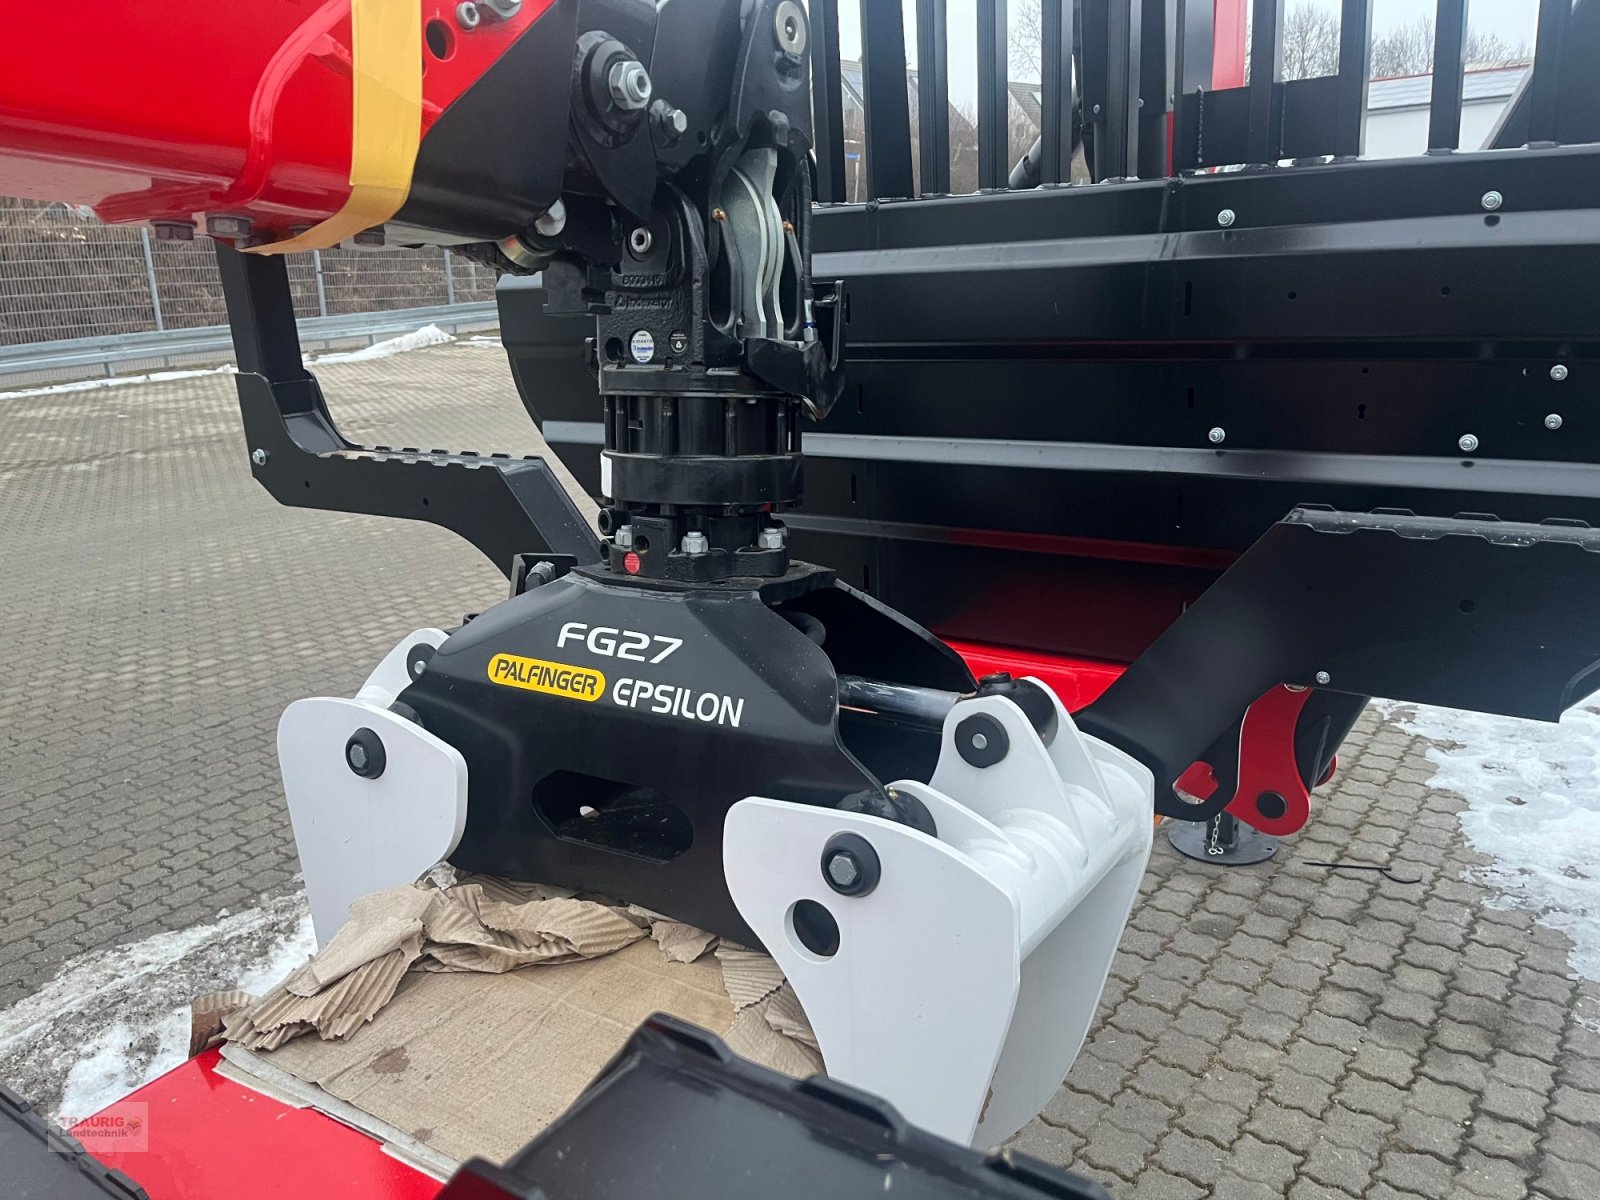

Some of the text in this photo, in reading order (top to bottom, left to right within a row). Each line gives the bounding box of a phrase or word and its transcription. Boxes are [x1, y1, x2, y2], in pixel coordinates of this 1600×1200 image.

[556, 622, 683, 664] FG27
[494, 658, 745, 728] PALFINGER EPSILON
